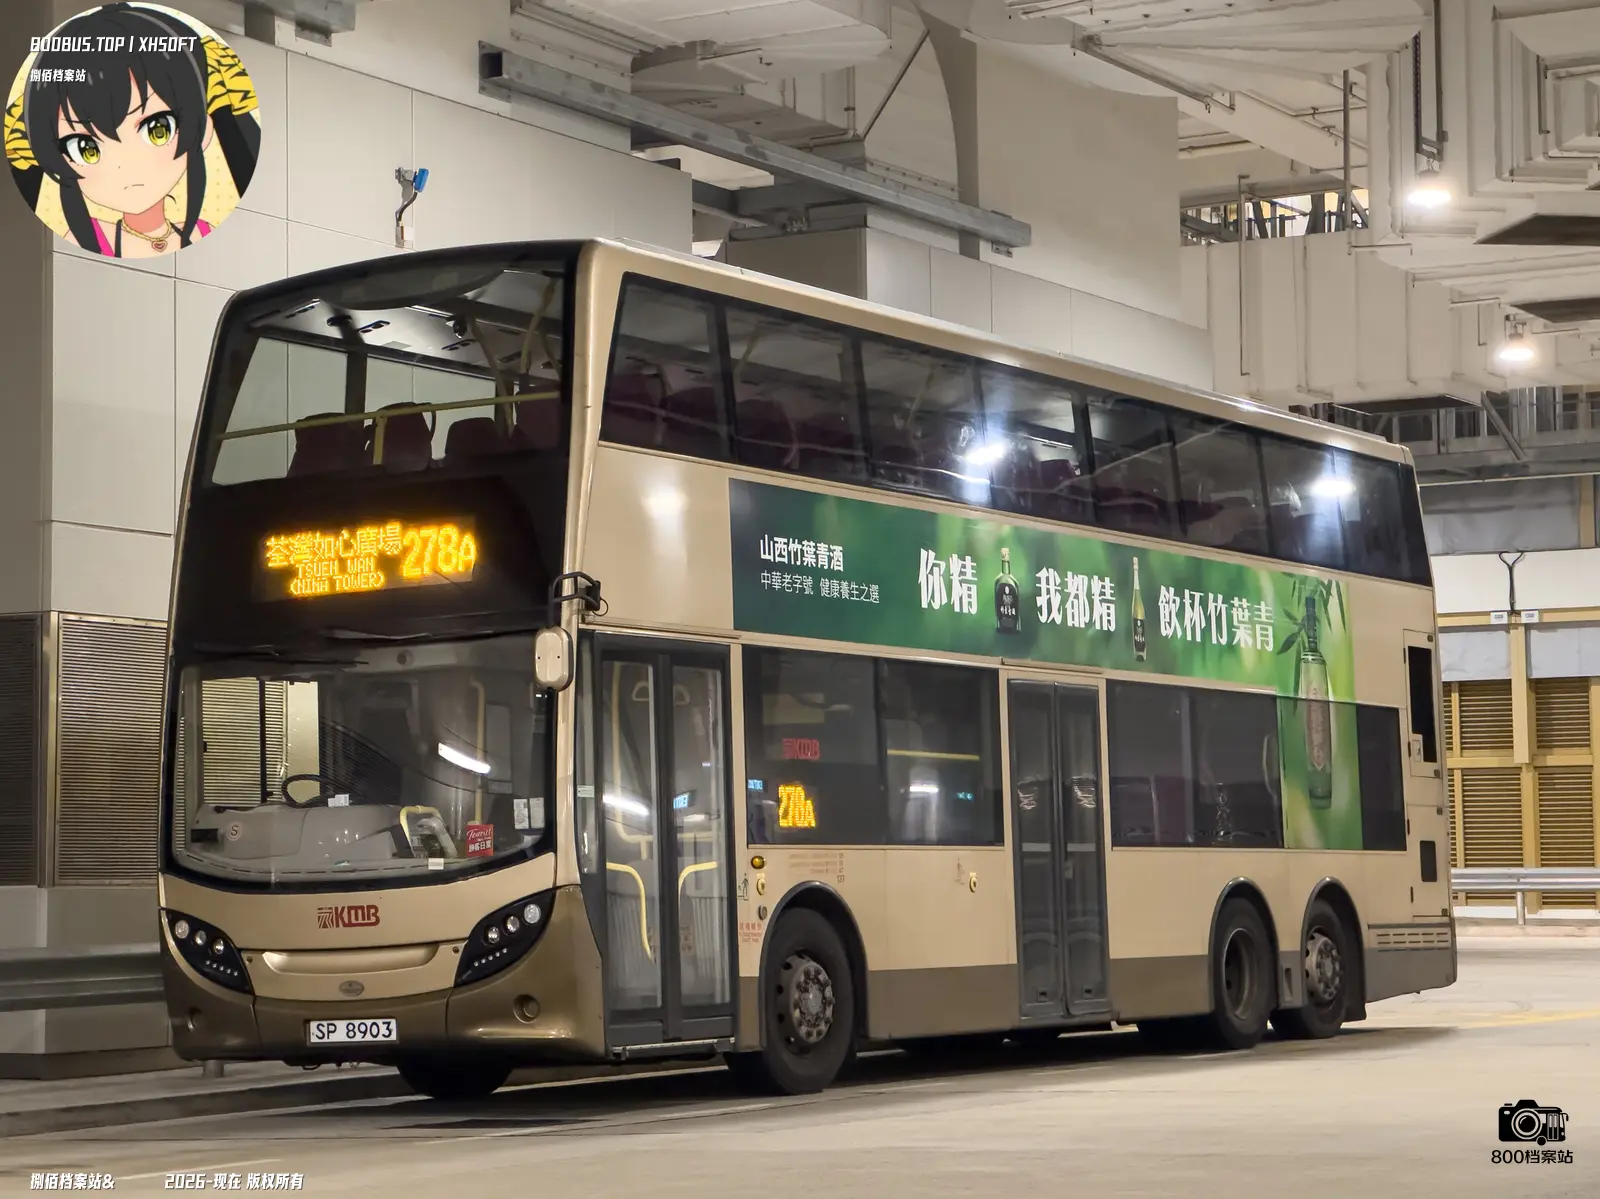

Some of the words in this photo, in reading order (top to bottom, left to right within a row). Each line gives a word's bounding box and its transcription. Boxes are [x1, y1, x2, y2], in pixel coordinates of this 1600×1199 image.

[266, 521, 401, 568] 荃灣如心廣場
[402, 523, 477, 578] 278A
[759, 534, 844, 572] 山西竹葉青酒
[298, 559, 339, 579] TSUEN
[347, 556, 375, 574] WAN
[333, 571, 385, 592] TOWER)
[760, 569, 814, 595] 中華老字號
[819, 577, 880, 604] 健康養生之選
[918, 547, 978, 615] 你精
[1035, 566, 1117, 632] 我都精
[1158, 584, 1274, 652] 飲杯竹葉青
[334, 905, 381, 928] KMB
[315, 1022, 337, 1040] SP
[345, 1020, 393, 1039] 8903
